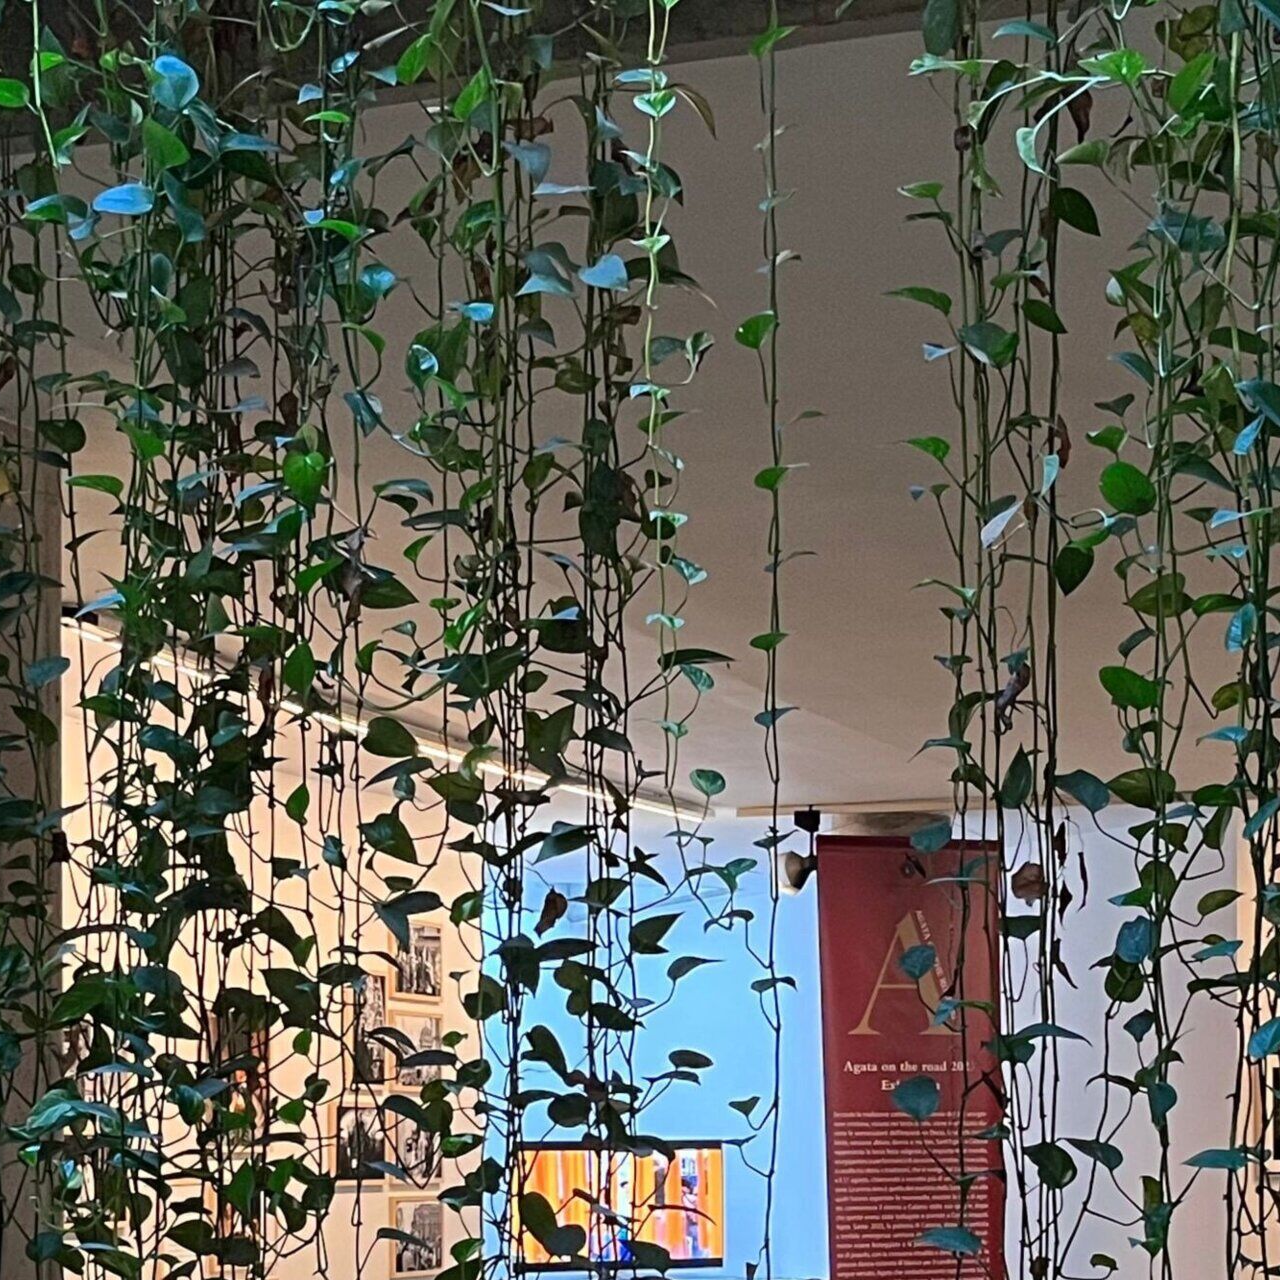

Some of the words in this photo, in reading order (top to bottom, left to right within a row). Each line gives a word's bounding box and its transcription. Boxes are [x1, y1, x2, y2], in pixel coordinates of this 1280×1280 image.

[843, 1060, 878, 1075] Agata
[880, 1064, 897, 1072] on
[899, 1061, 919, 1072] the
[921, 1060, 947, 1072] road
[951, 1061, 974, 1072] 202
